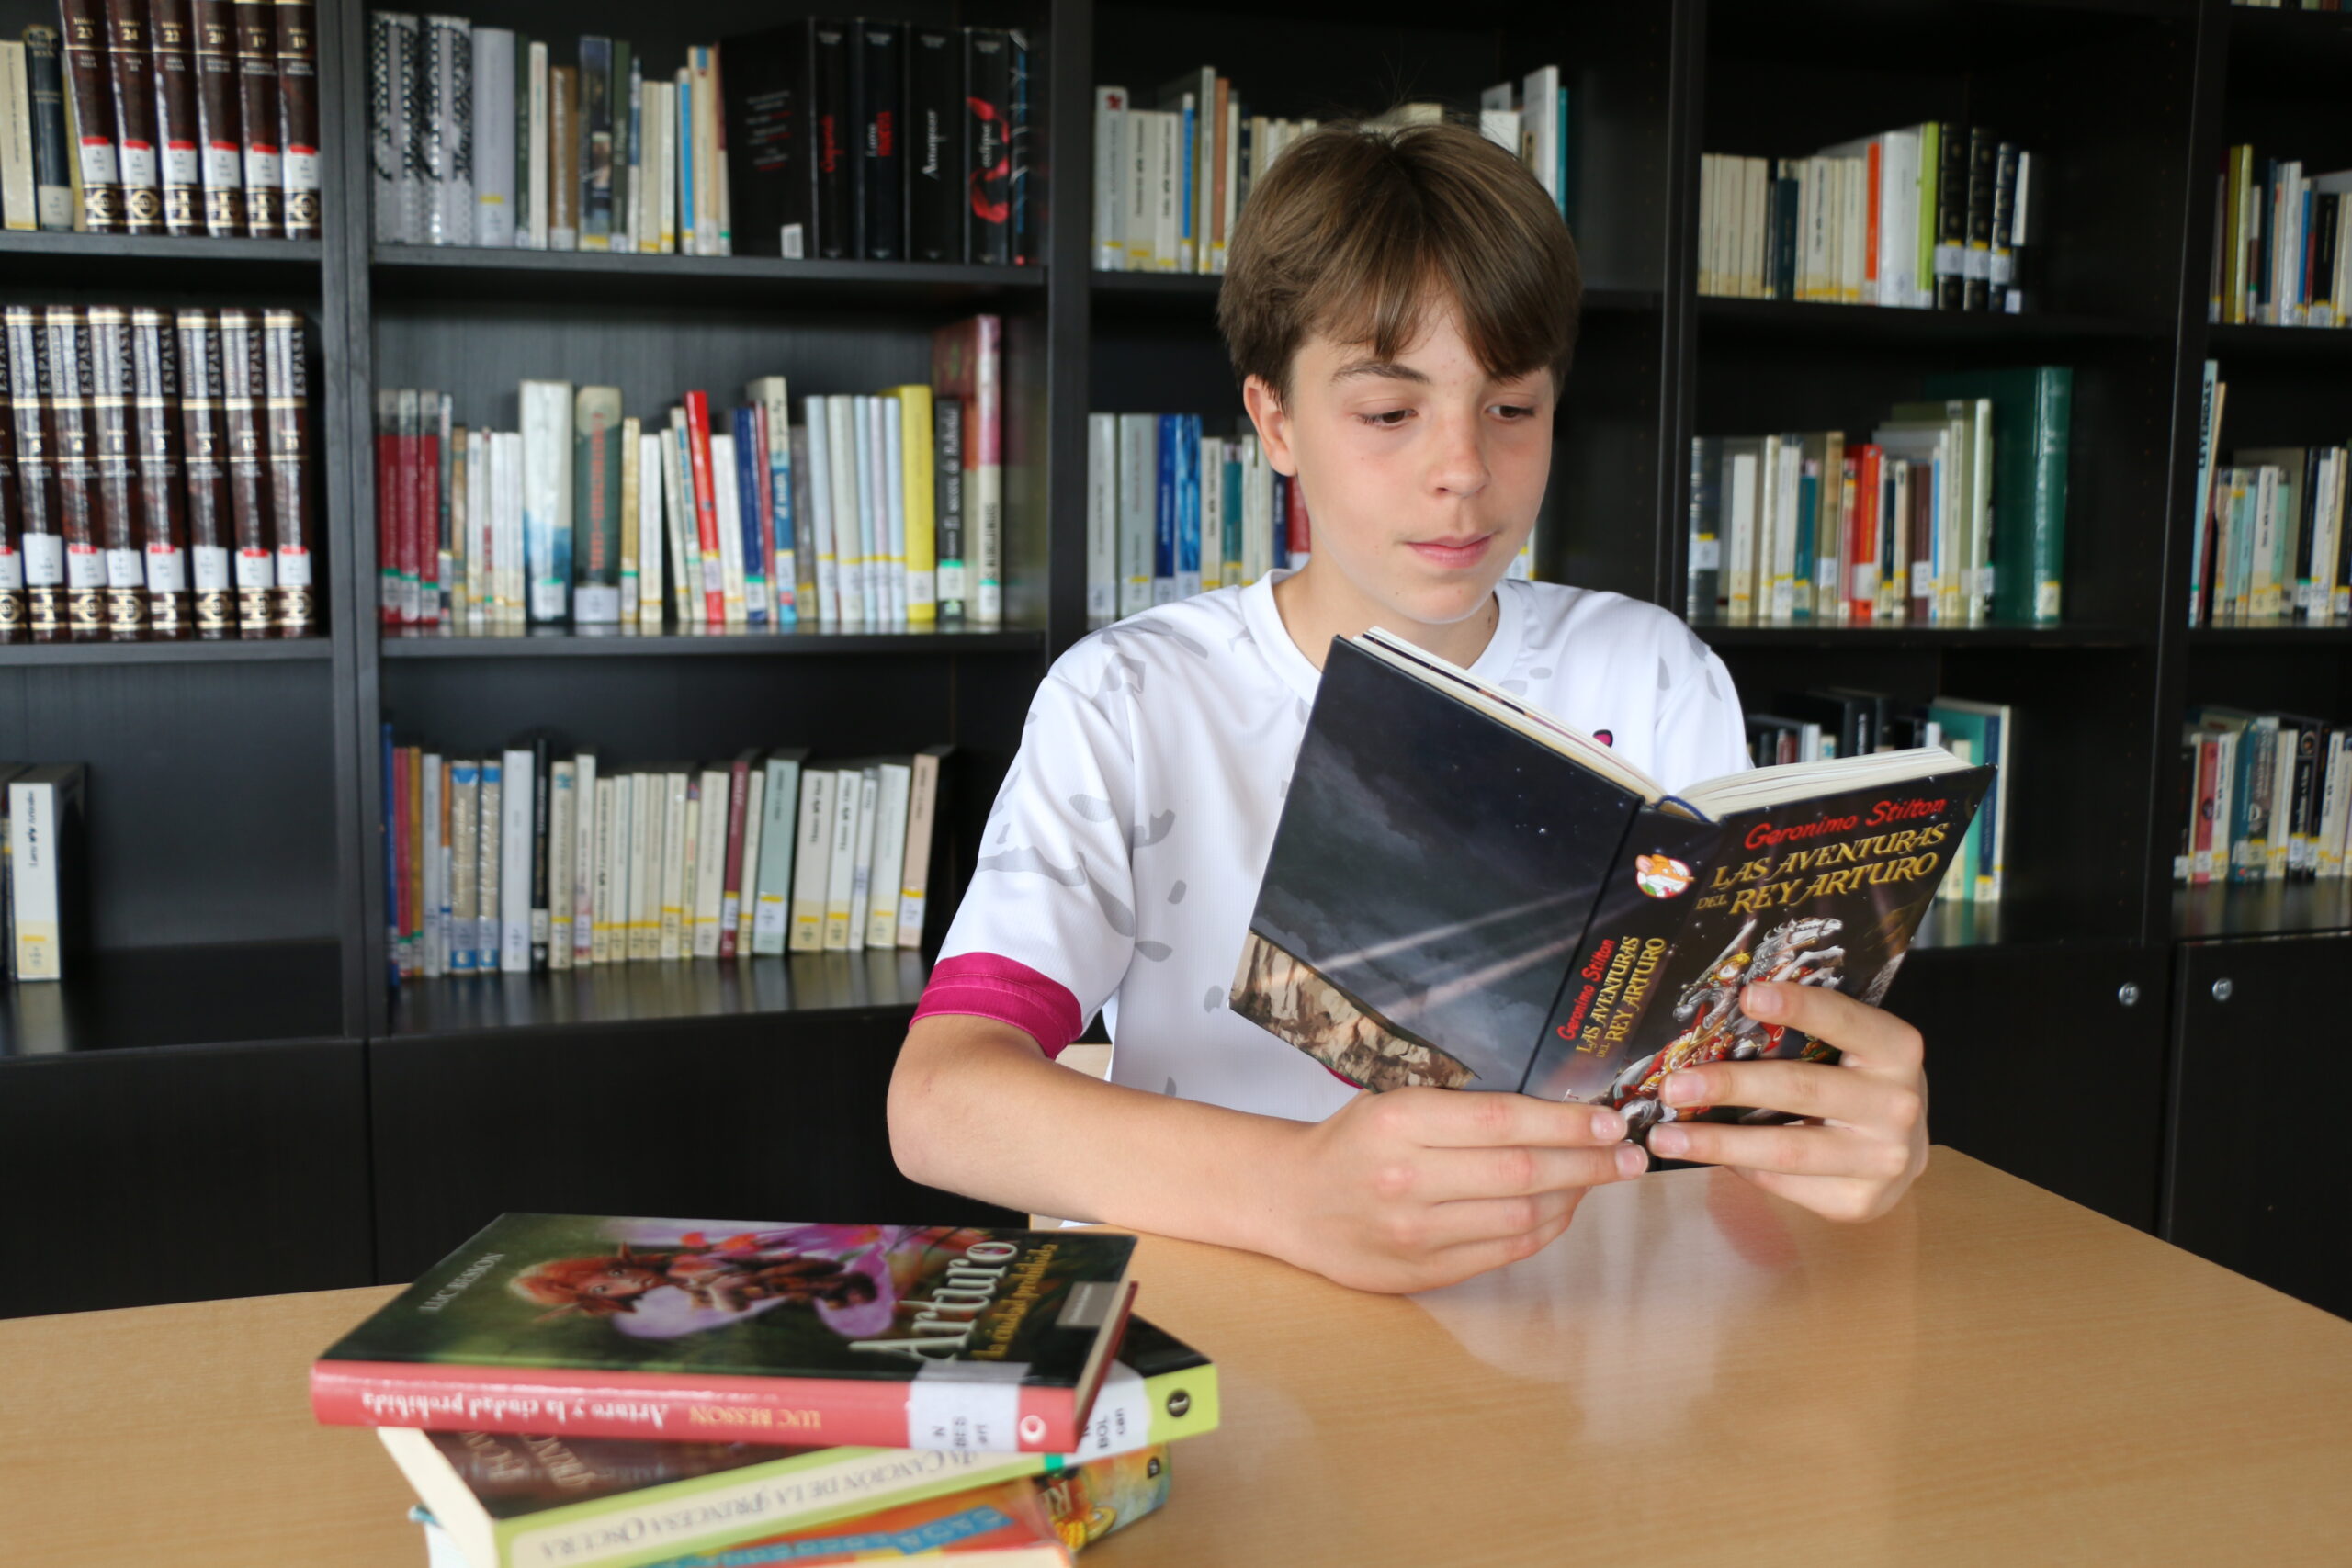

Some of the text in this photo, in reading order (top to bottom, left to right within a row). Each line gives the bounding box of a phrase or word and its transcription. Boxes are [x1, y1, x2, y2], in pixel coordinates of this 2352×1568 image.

[164, 29, 180, 43] 22
[36, 327, 51, 394] ESPASA
[77, 327, 93, 394] ESPASA
[119, 325, 135, 394] ESPASA
[160, 327, 176, 394] ESPASA
[206, 328, 221, 396] ESPASA
[248, 329, 264, 396] ESPASA
[291, 329, 308, 397] ESPASA
[1710, 856, 1771, 891] LAS
[1764, 822, 1950, 880] AVENTURAS
[1746, 814, 1859, 850] Geronimo
[1865, 798, 1947, 826] Stilton
[1695, 852, 1939, 916] DEL REY ARTURO
[1556, 938, 1615, 1041] Geronimo Stilton
[1575, 935, 1640, 1054] LAS AVENTURAS
[1597, 937, 1667, 1058] DEL REY ARTURO
[418, 1252, 505, 1314] LUC BESSON
[847, 1241, 1018, 1362] Arturo
[969, 1243, 1059, 1358] la ciudad prohibida
[362, 1391, 669, 1430] Arturo y la ciudad prohibida
[689, 1404, 822, 1429] LUC BESSON
[1095, 1417, 1110, 1450] BOL
[1114, 1407, 1125, 1437] can
[775, 1484, 805, 1506] LA
[809, 1480, 840, 1498] DE
[842, 1450, 944, 1489] CANCIÓN
[653, 1485, 772, 1533] PRINCESA
